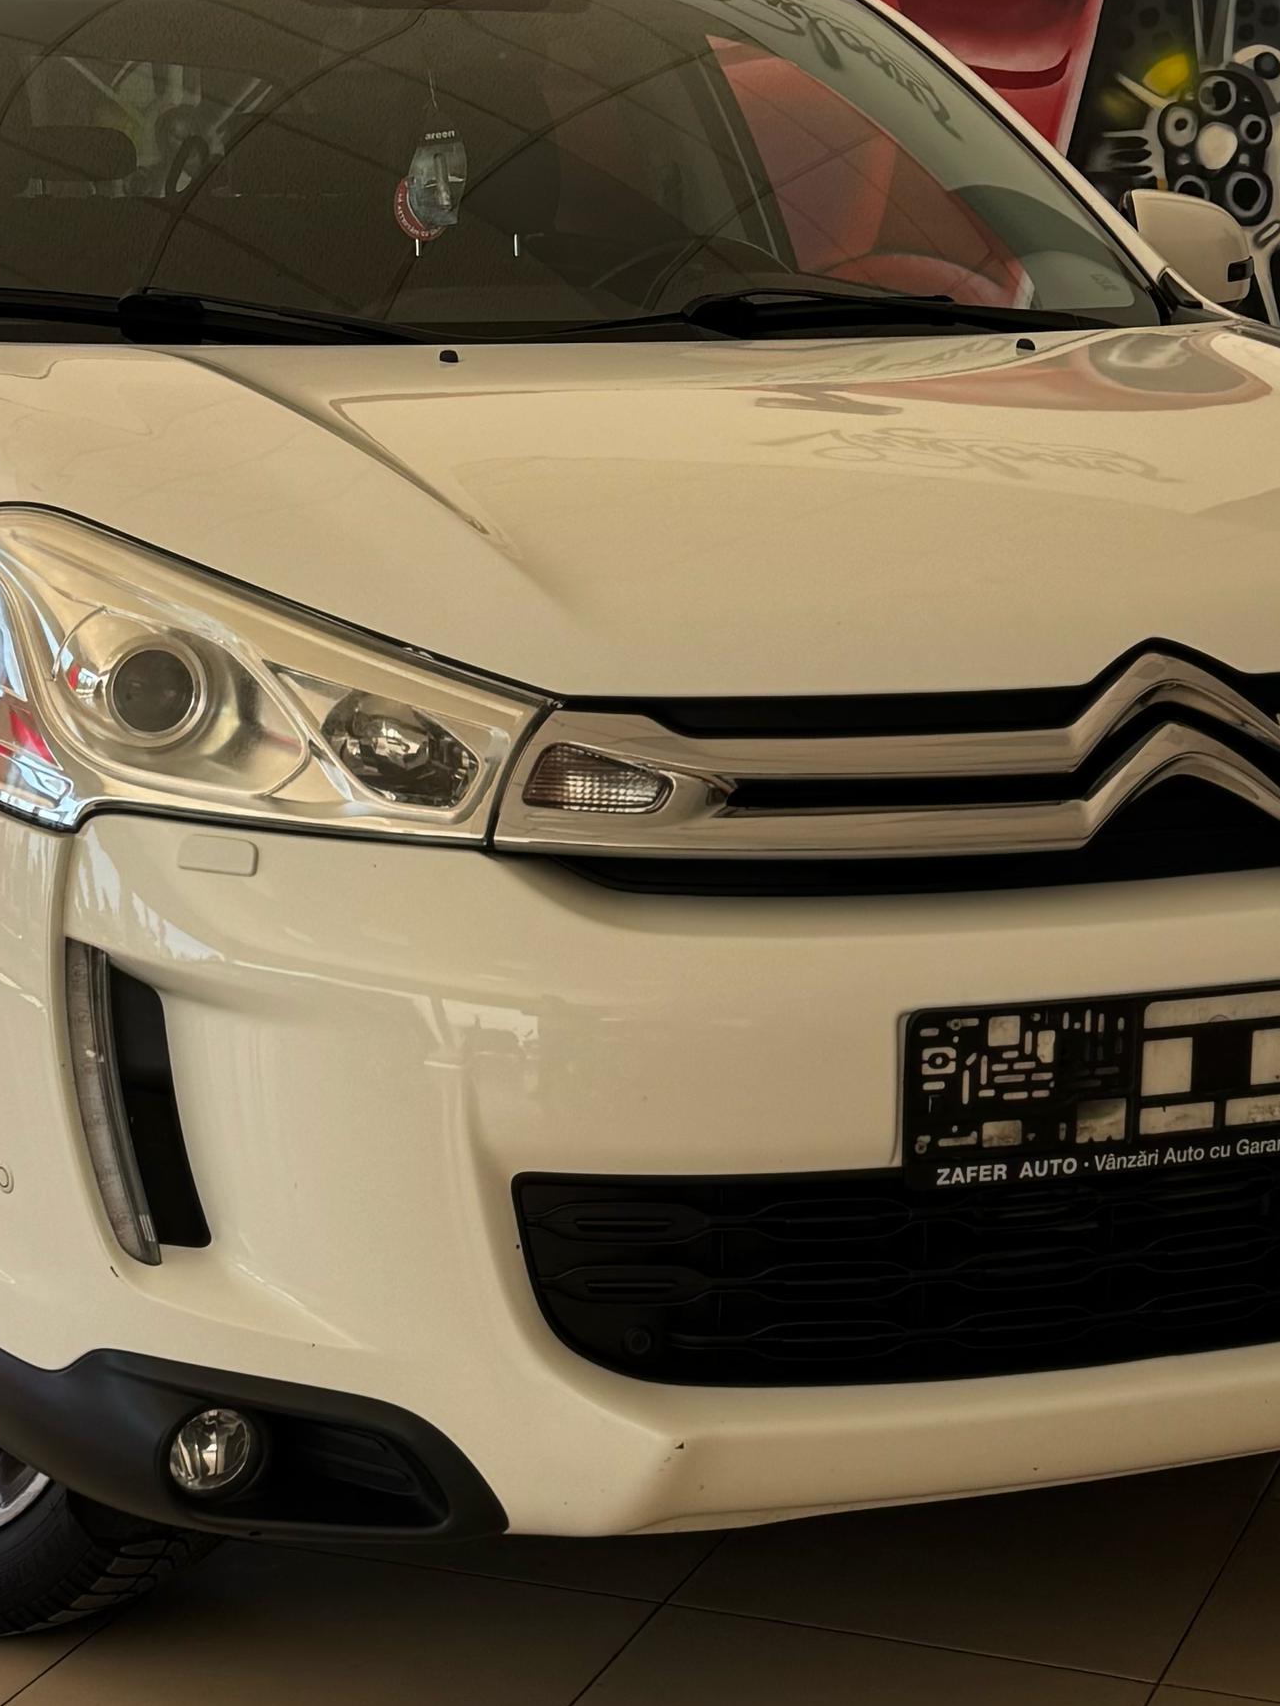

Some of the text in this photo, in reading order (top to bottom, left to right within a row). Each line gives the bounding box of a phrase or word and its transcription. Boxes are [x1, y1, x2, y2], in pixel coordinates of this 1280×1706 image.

[936, 1163, 1008, 1186] ZAFER
[1019, 1157, 1078, 1179] AUTO
[1094, 1149, 1160, 1172] Vânzări
[1163, 1145, 1206, 1164] Auto
[1209, 1146, 1231, 1159] cu
